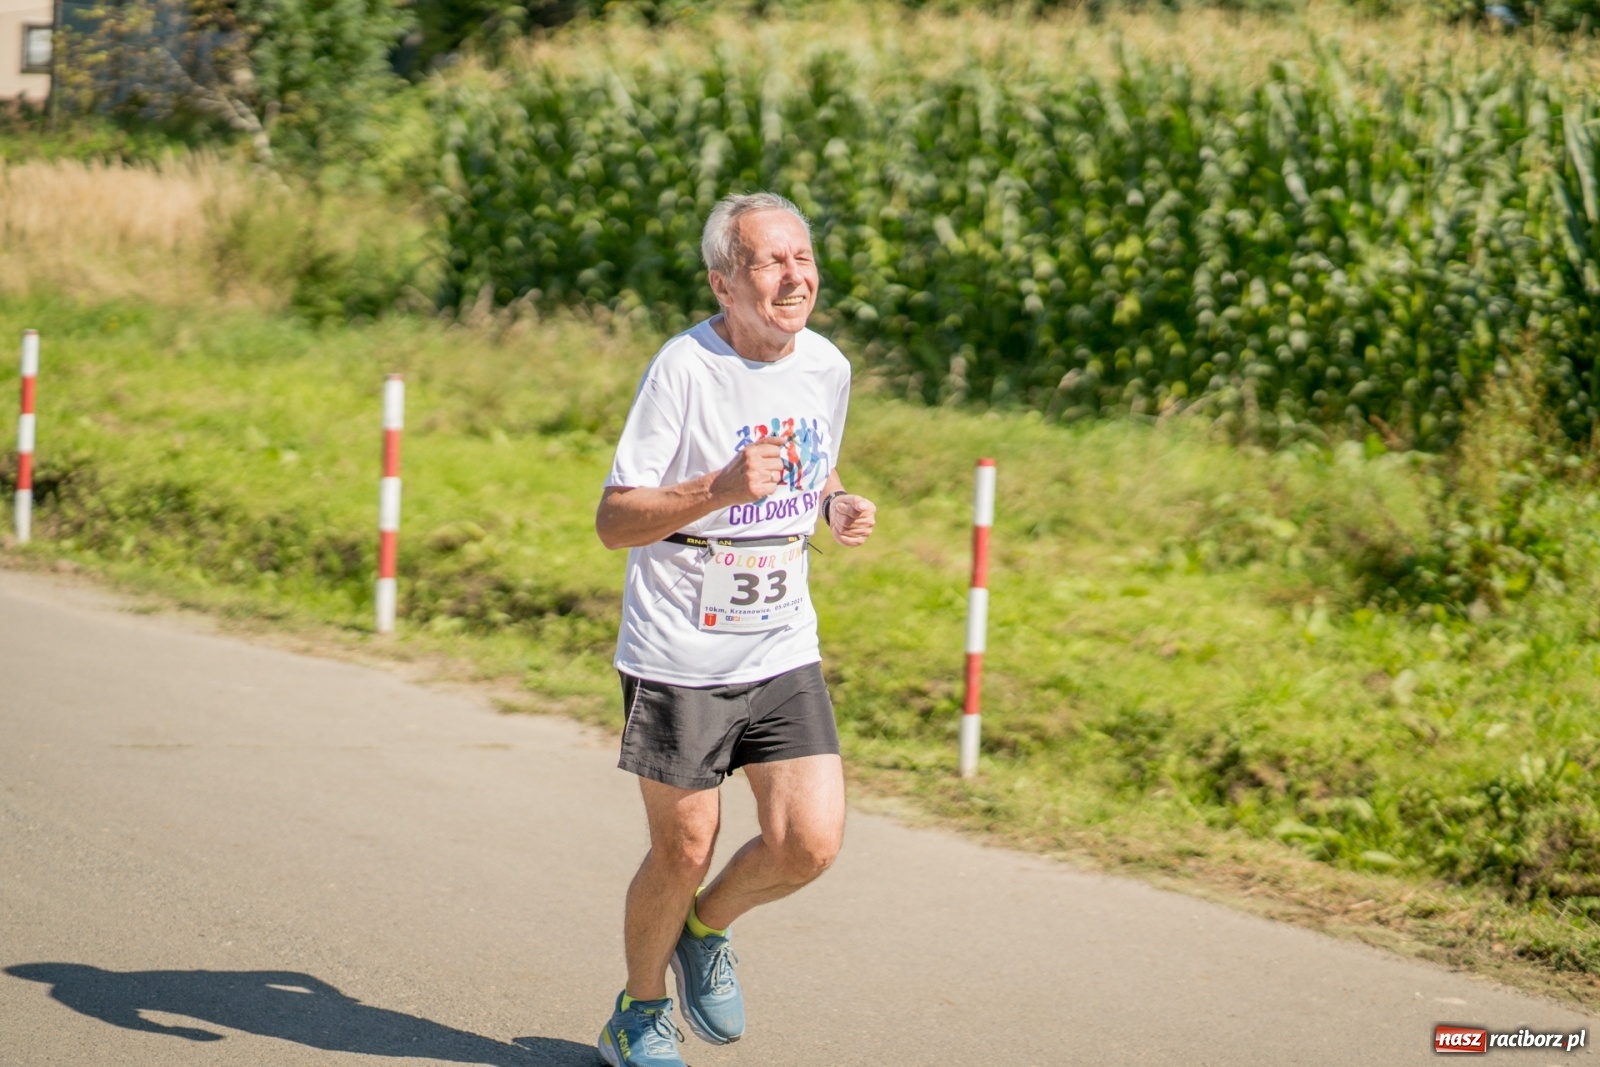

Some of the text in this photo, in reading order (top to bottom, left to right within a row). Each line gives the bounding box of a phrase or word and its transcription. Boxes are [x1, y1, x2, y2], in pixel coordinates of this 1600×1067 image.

[729, 497, 800, 525] COLOUR
[694, 538, 732, 546] NAAN
[715, 547, 802, 569] COLOUR RUN
[729, 569, 787, 606] 33
[705, 606, 727, 615] 10km,
